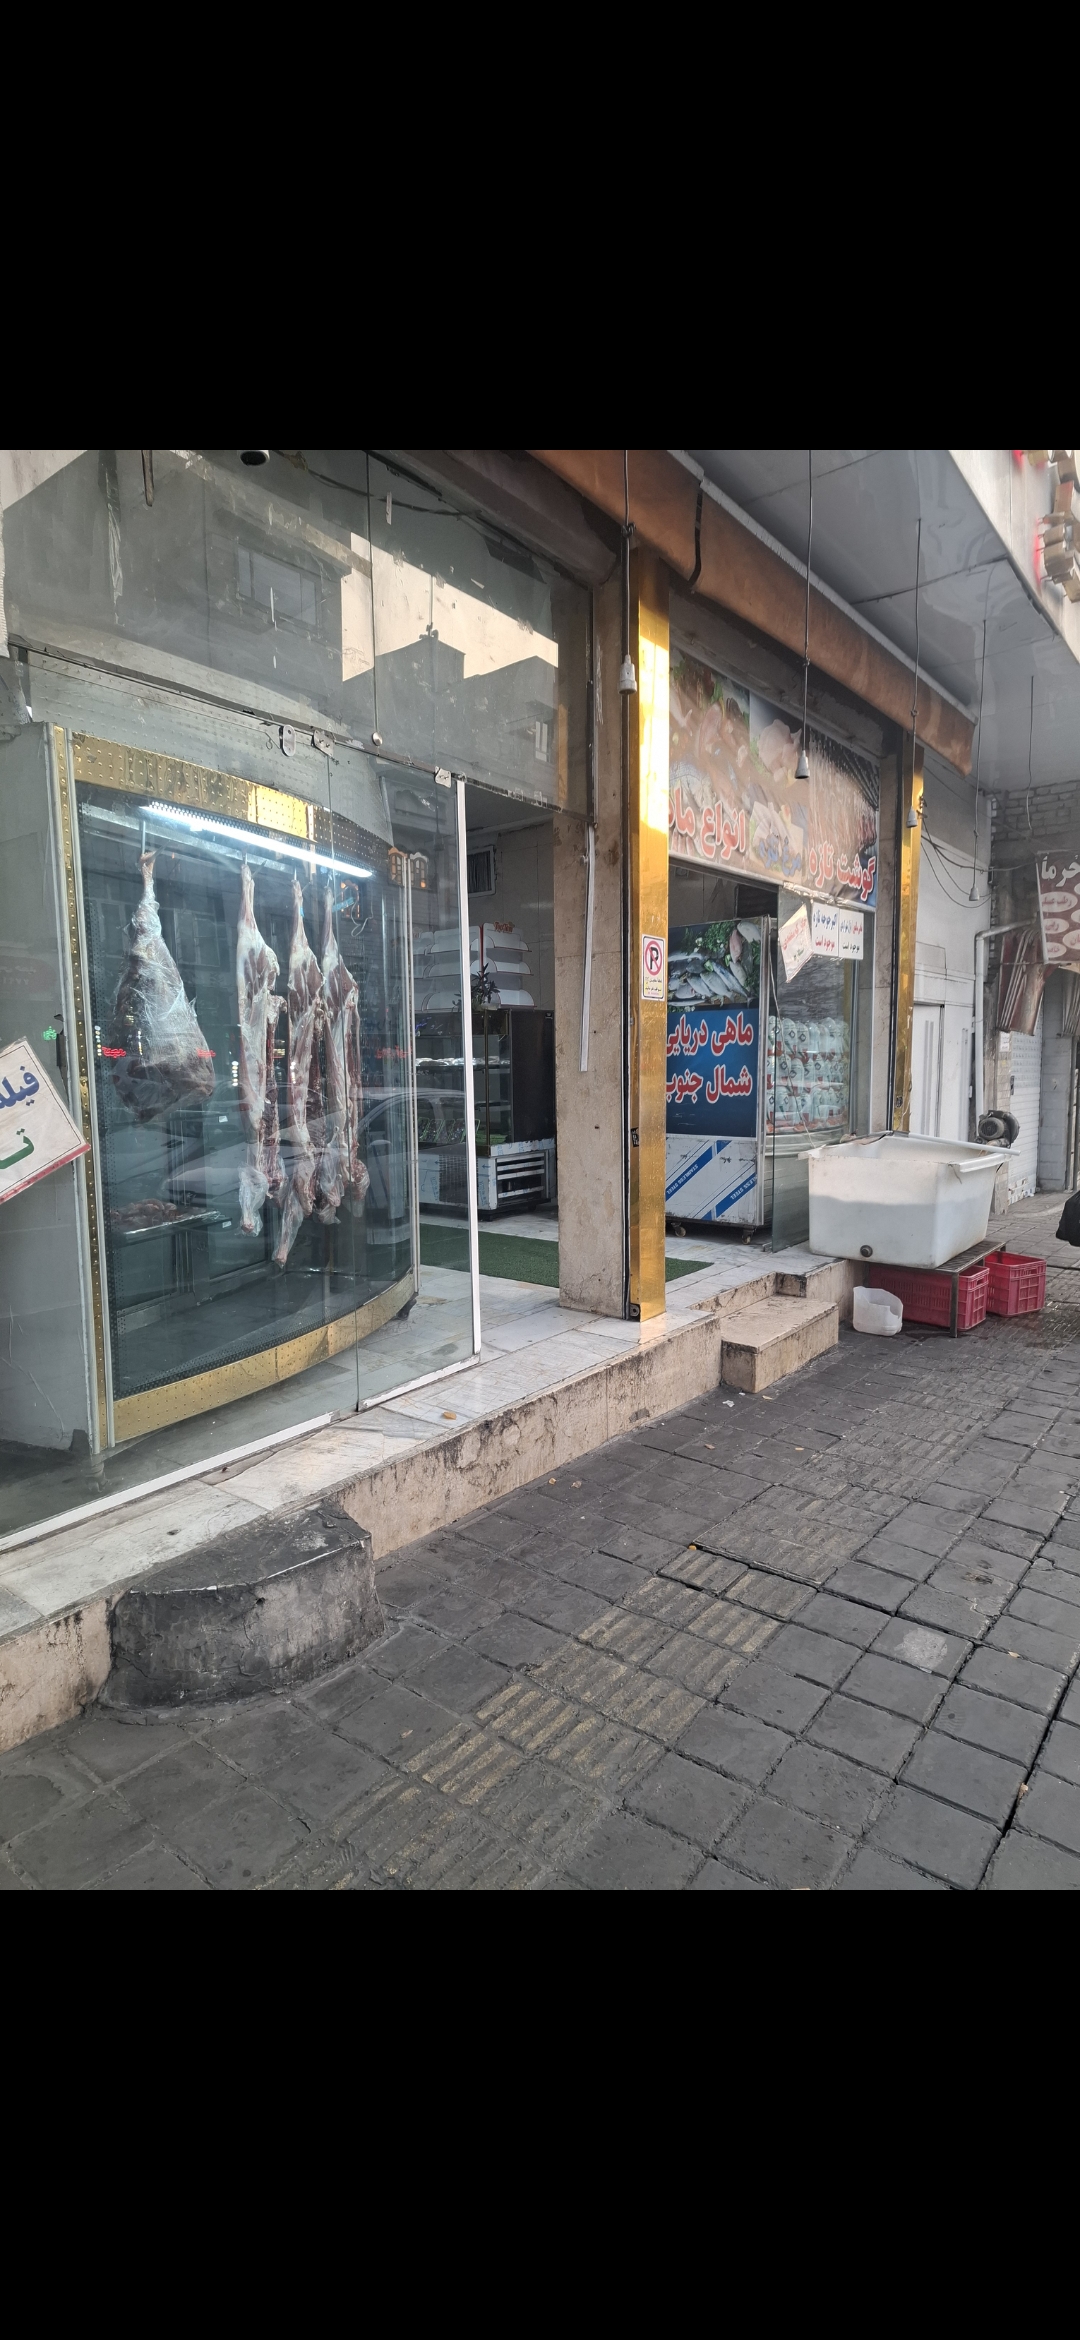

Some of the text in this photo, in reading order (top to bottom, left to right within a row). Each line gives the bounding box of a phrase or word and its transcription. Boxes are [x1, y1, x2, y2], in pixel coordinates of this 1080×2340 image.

[700, 800, 746, 860] انواع
[782, 835, 802, 877] مرغ
[809, 841, 876, 902] گوشت تازه
[815, 935, 835, 952] موجود است
[850, 943, 860, 954] موجود
[667, 1011, 754, 1057] ماهی دریایی
[705, 1064, 753, 1104] شمال
[666, 1163, 699, 1195] STAINLESS STEEL
[730, 1187, 744, 1200] STEEL
